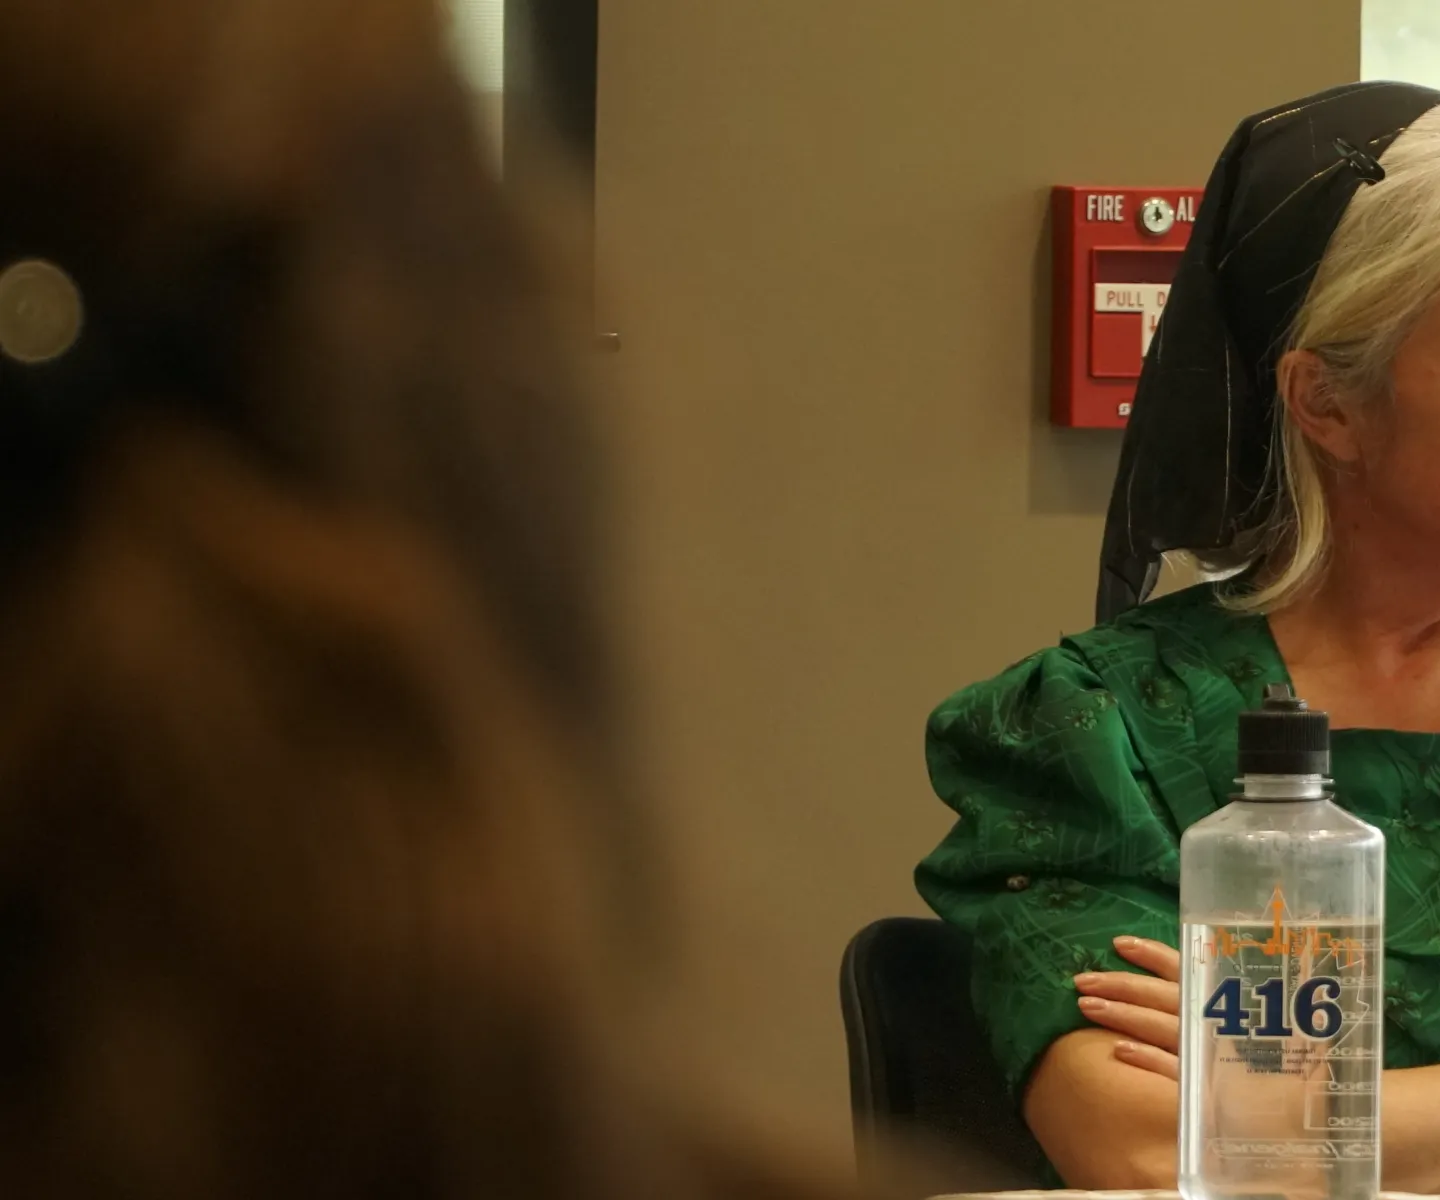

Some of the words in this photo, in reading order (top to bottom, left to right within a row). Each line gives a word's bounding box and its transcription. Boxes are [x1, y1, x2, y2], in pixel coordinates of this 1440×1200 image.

[1087, 194, 1125, 222] FIRE
[1106, 290, 1145, 308] PULL
[1203, 976, 1343, 1041] 416
